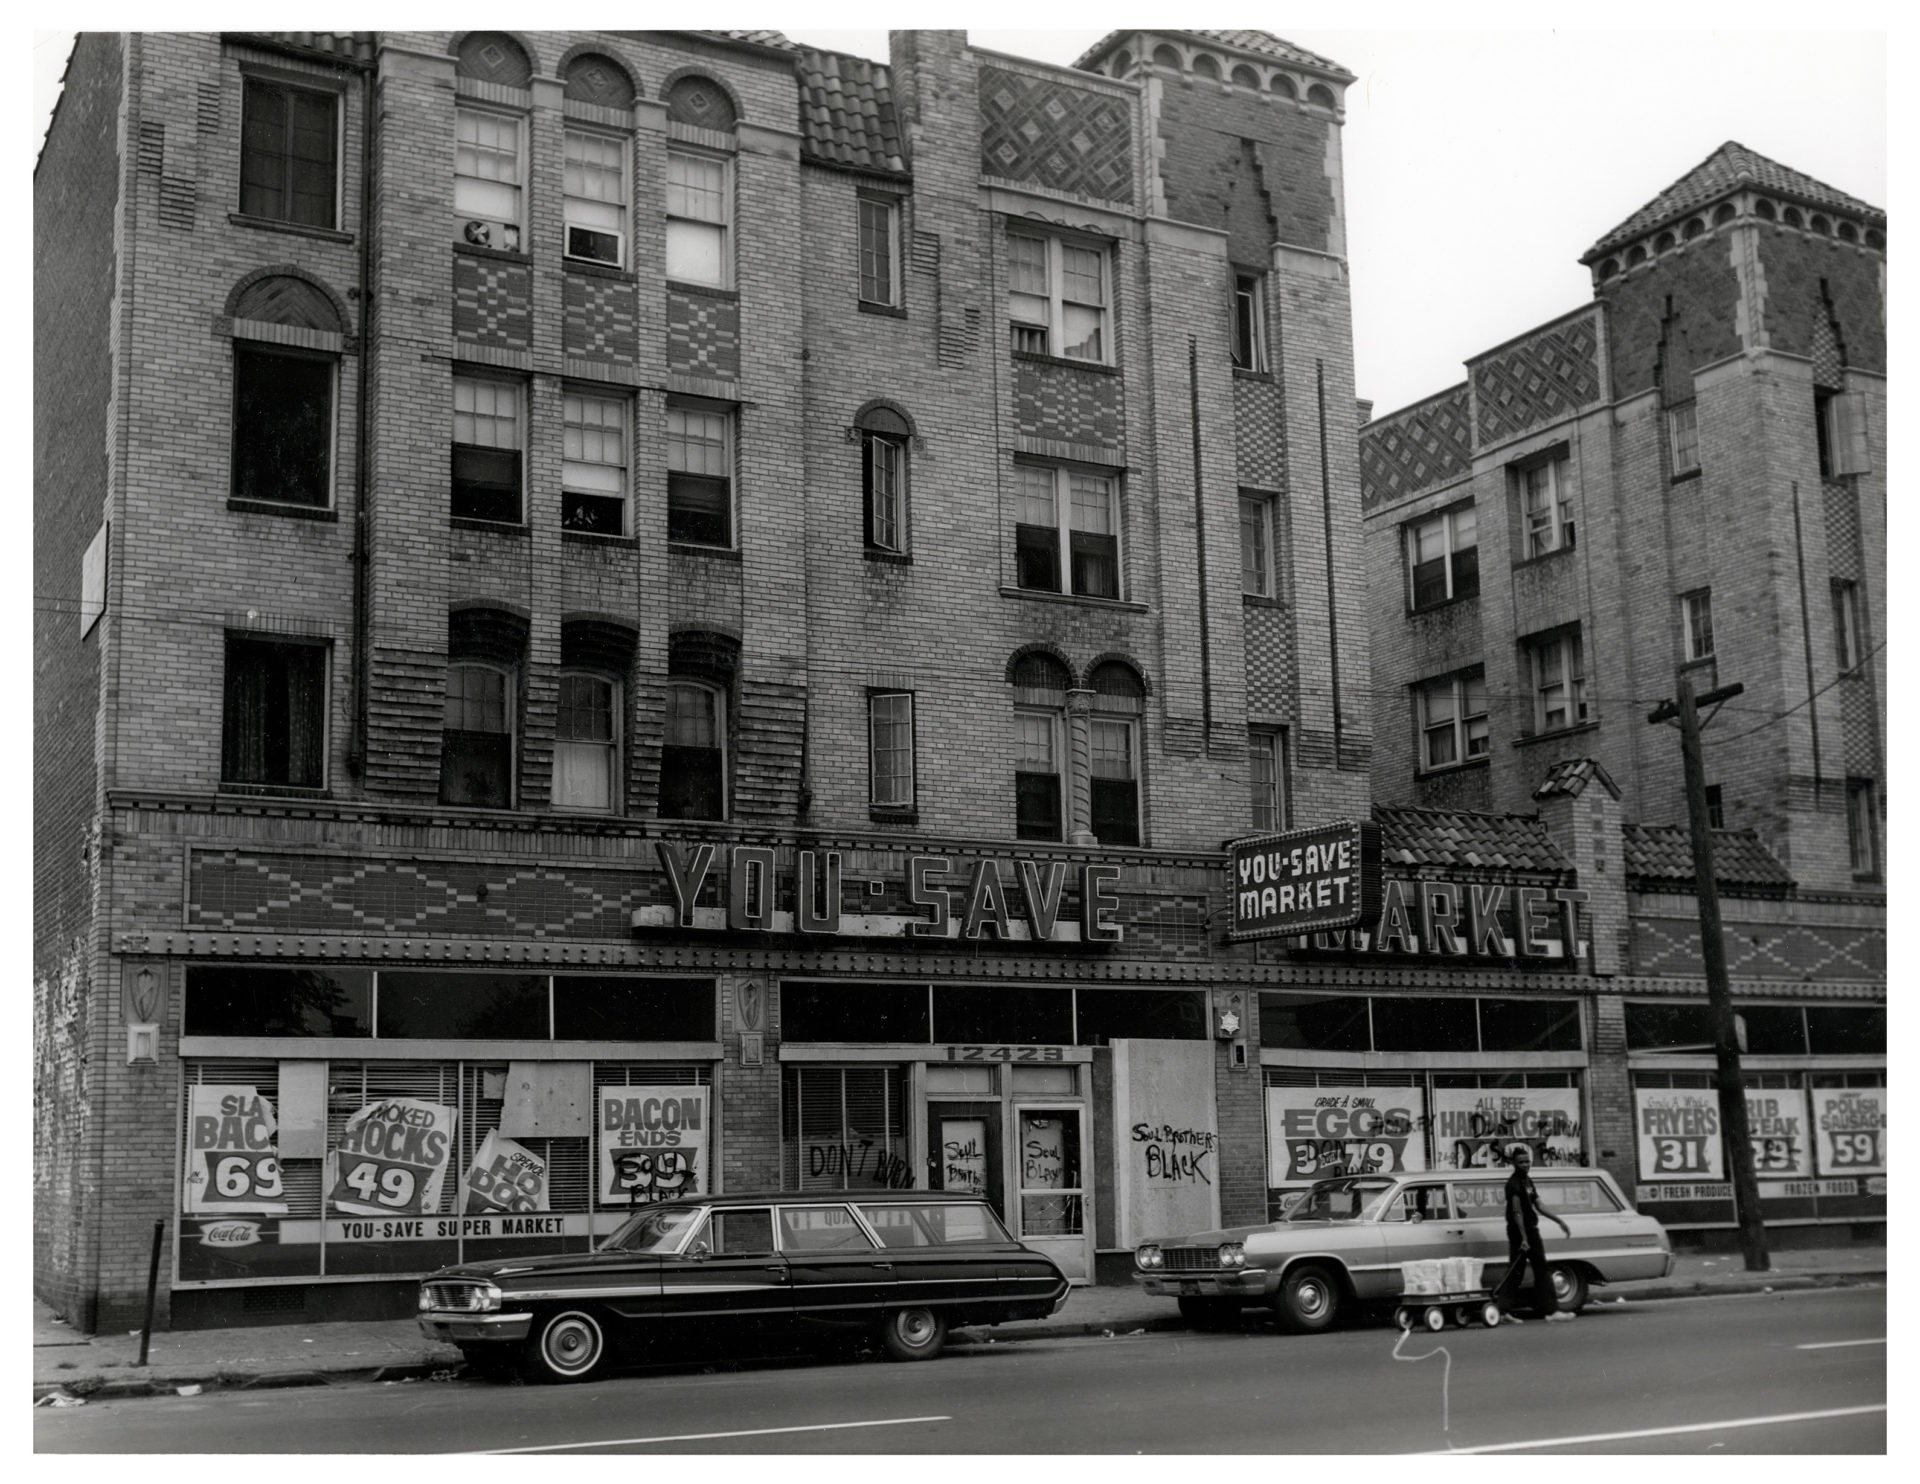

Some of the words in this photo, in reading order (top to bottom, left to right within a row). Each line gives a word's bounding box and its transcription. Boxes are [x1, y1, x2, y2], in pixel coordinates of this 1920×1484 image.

[1239, 877, 1350, 920] MARKET
[1307, 880, 1591, 957] ARKET
[604, 1098, 702, 1131] BACON
[1475, 1097, 1496, 1110] ALL
[1501, 1097, 1526, 1110] BEEF
[1826, 1098, 1879, 1116] POLISH
[1280, 1107, 1413, 1138] EGGS
[1642, 1107, 1718, 1136] FRYERS
[1749, 1117, 1800, 1136] TEAK
[1820, 1112, 1886, 1131] SAUSAGE
[618, 1131, 682, 1146] ENDS
[1836, 1133, 1874, 1164] 59
[1145, 1144, 1211, 1185] BLACK
[1345, 1143, 1395, 1173] 79
[1660, 1139, 1699, 1170] 31
[215, 1156, 284, 1198] 69
[346, 1161, 416, 1207] 49
[1664, 1186, 1691, 1199] FRESH
[1694, 1184, 1732, 1198] PRODUCE
[1784, 1182, 1821, 1195] FROZEN
[1826, 1181, 1856, 1194] FOODS
[342, 1222, 424, 1239] YOU-SAVE
[437, 1220, 492, 1237] SUPER
[502, 1218, 564, 1234] MARKET
